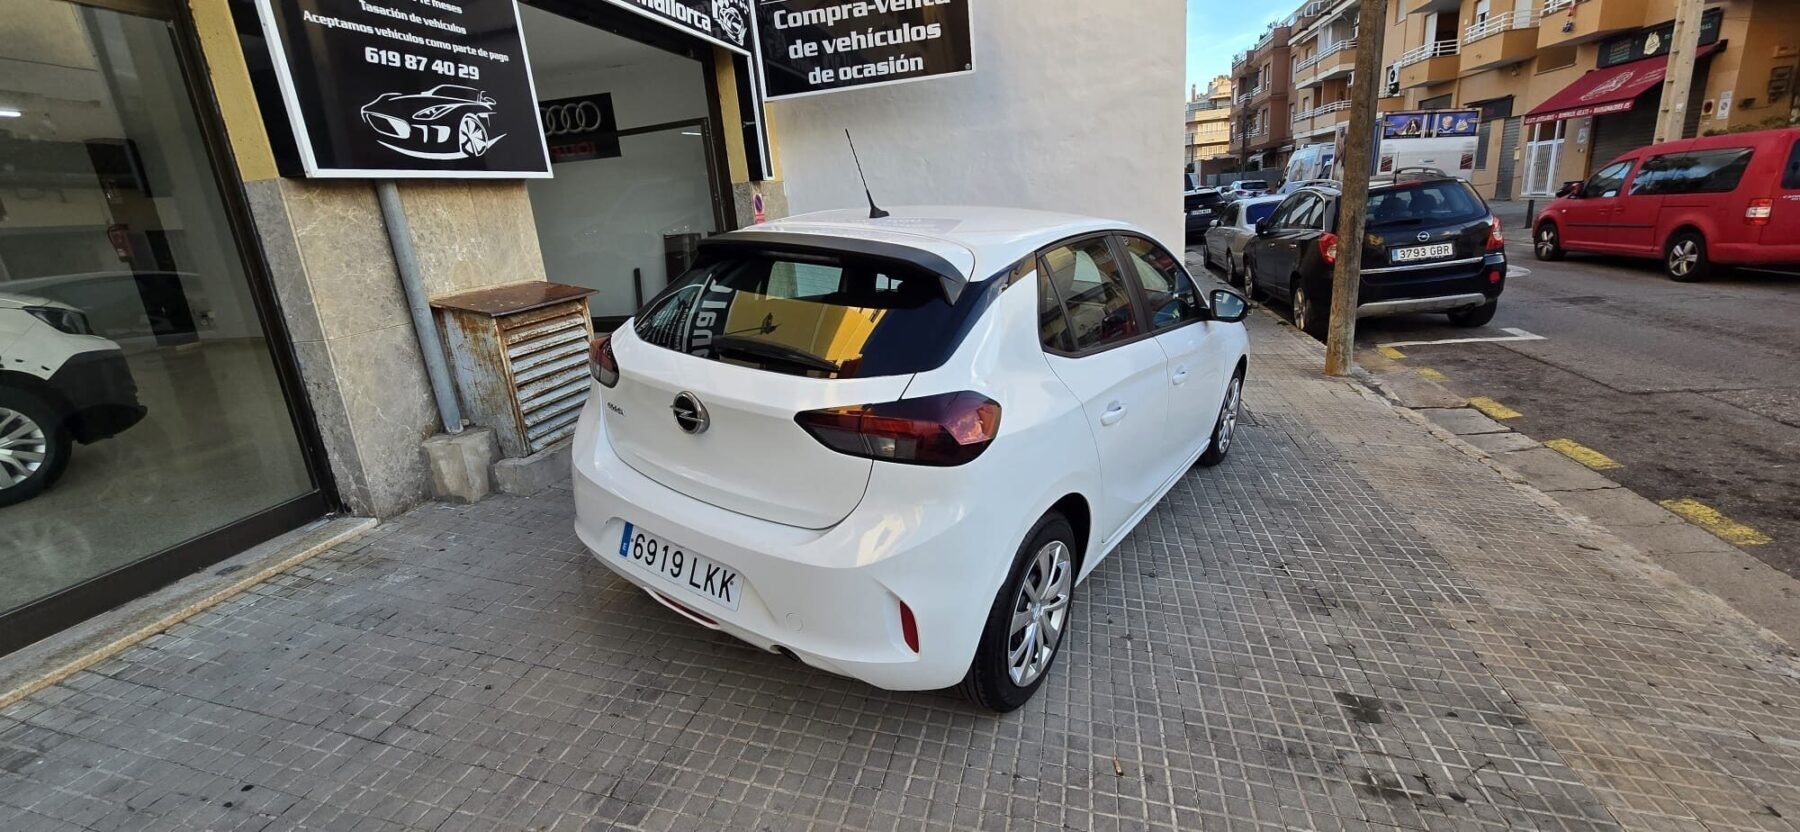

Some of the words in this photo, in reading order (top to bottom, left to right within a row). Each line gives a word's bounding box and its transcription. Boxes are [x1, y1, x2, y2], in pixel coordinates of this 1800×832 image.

[359, 0, 408, 21] Tasación
[409, 13, 422, 24] de
[432, 0, 463, 14] meses
[303, 10, 374, 34] Aceptamos
[425, 38, 452, 50] como
[452, 44, 477, 55] parte
[477, 48, 489, 58] de
[489, 51, 510, 63] pago
[788, 40, 819, 59] de
[821, 22, 942, 54] vehículos
[364, 46, 401, 68] 619
[404, 54, 428, 71] 87
[431, 59, 455, 76] 40
[458, 63, 480, 80] 29
[808, 66, 835, 85] de
[838, 54, 924, 81] ocasión
[1399, 247, 1427, 259] 3793
[1429, 245, 1450, 256] GBR
[633, 533, 684, 578] 6919
[689, 557, 736, 603] LKK
